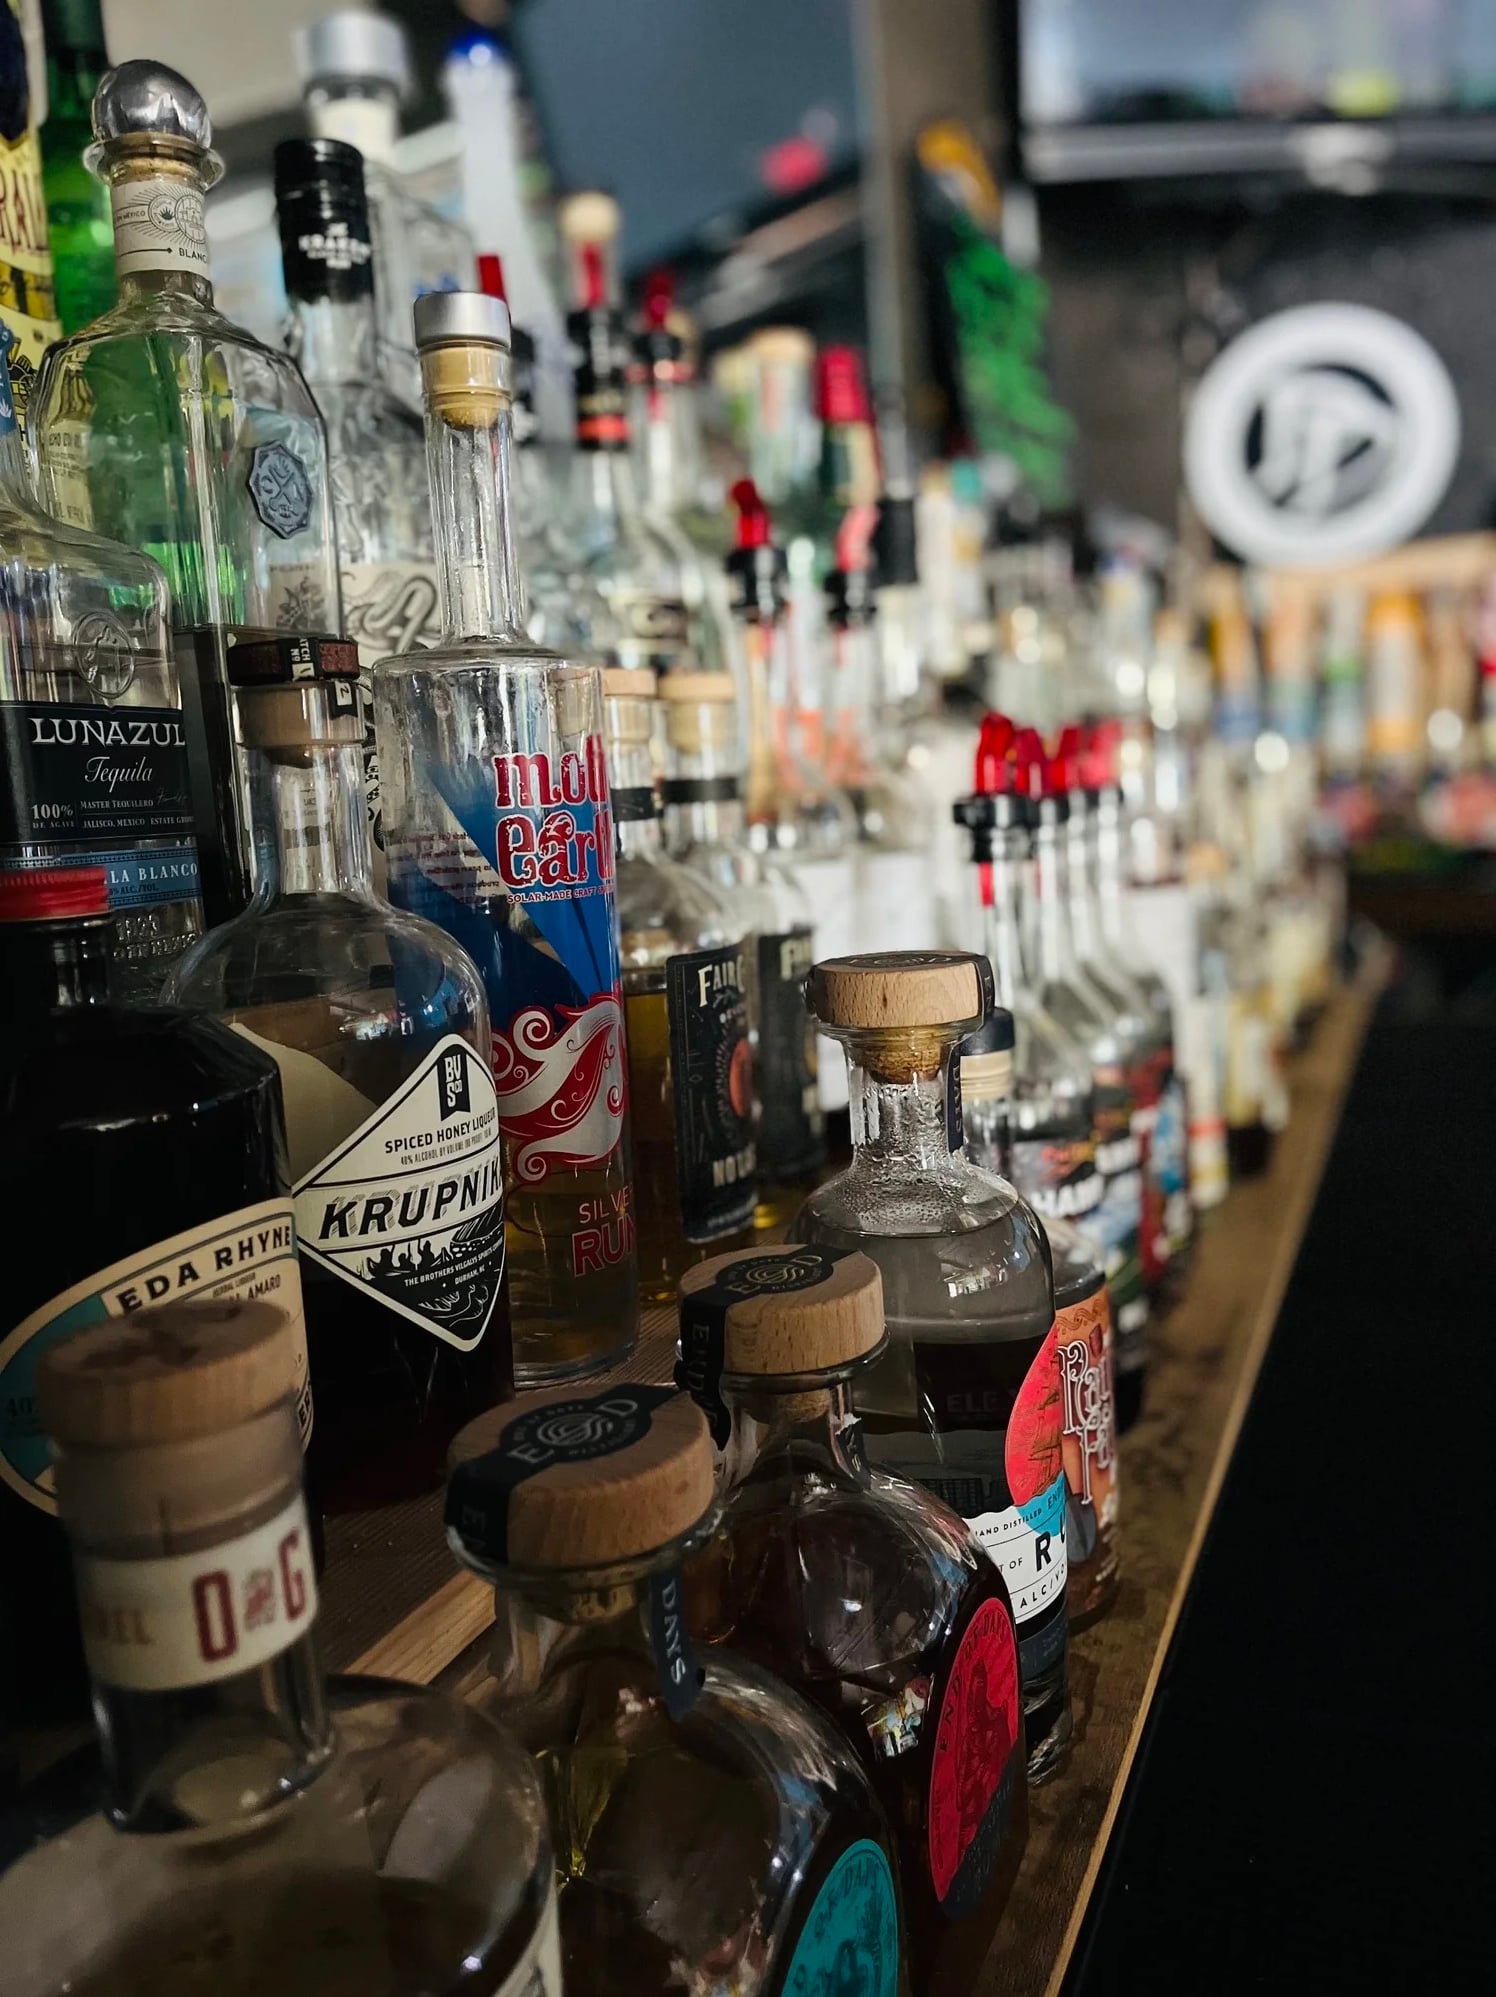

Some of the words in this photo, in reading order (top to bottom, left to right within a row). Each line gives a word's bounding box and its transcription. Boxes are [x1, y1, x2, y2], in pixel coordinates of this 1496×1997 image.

[179, 247, 207, 264] BLANC
[28, 717, 186, 747] LUNAZUL
[84, 756, 153, 793] Tequila
[32, 803, 74, 819] 100%
[80, 801, 110, 809] MASTER
[138, 862, 199, 881] BLANCO
[507, 888, 572, 905] SOLAR-MADE
[385, 1132, 433, 1154] SPICED
[436, 1120, 471, 1143] HONEY
[472, 1106, 496, 1131] LIQUEUR
[319, 1157, 500, 1240] KRUPNIK
[578, 1185, 631, 1224] SILVE
[117, 1262, 200, 1316] EDA
[214, 1225, 291, 1272] RHYNE
[404, 1276, 419, 1287] THE
[420, 1265, 454, 1283] BROTHERS
[975, 1526, 999, 1538] AND
[1003, 1507, 1042, 1531] DISTILLED
[1008, 1556, 1023, 1570] OF
